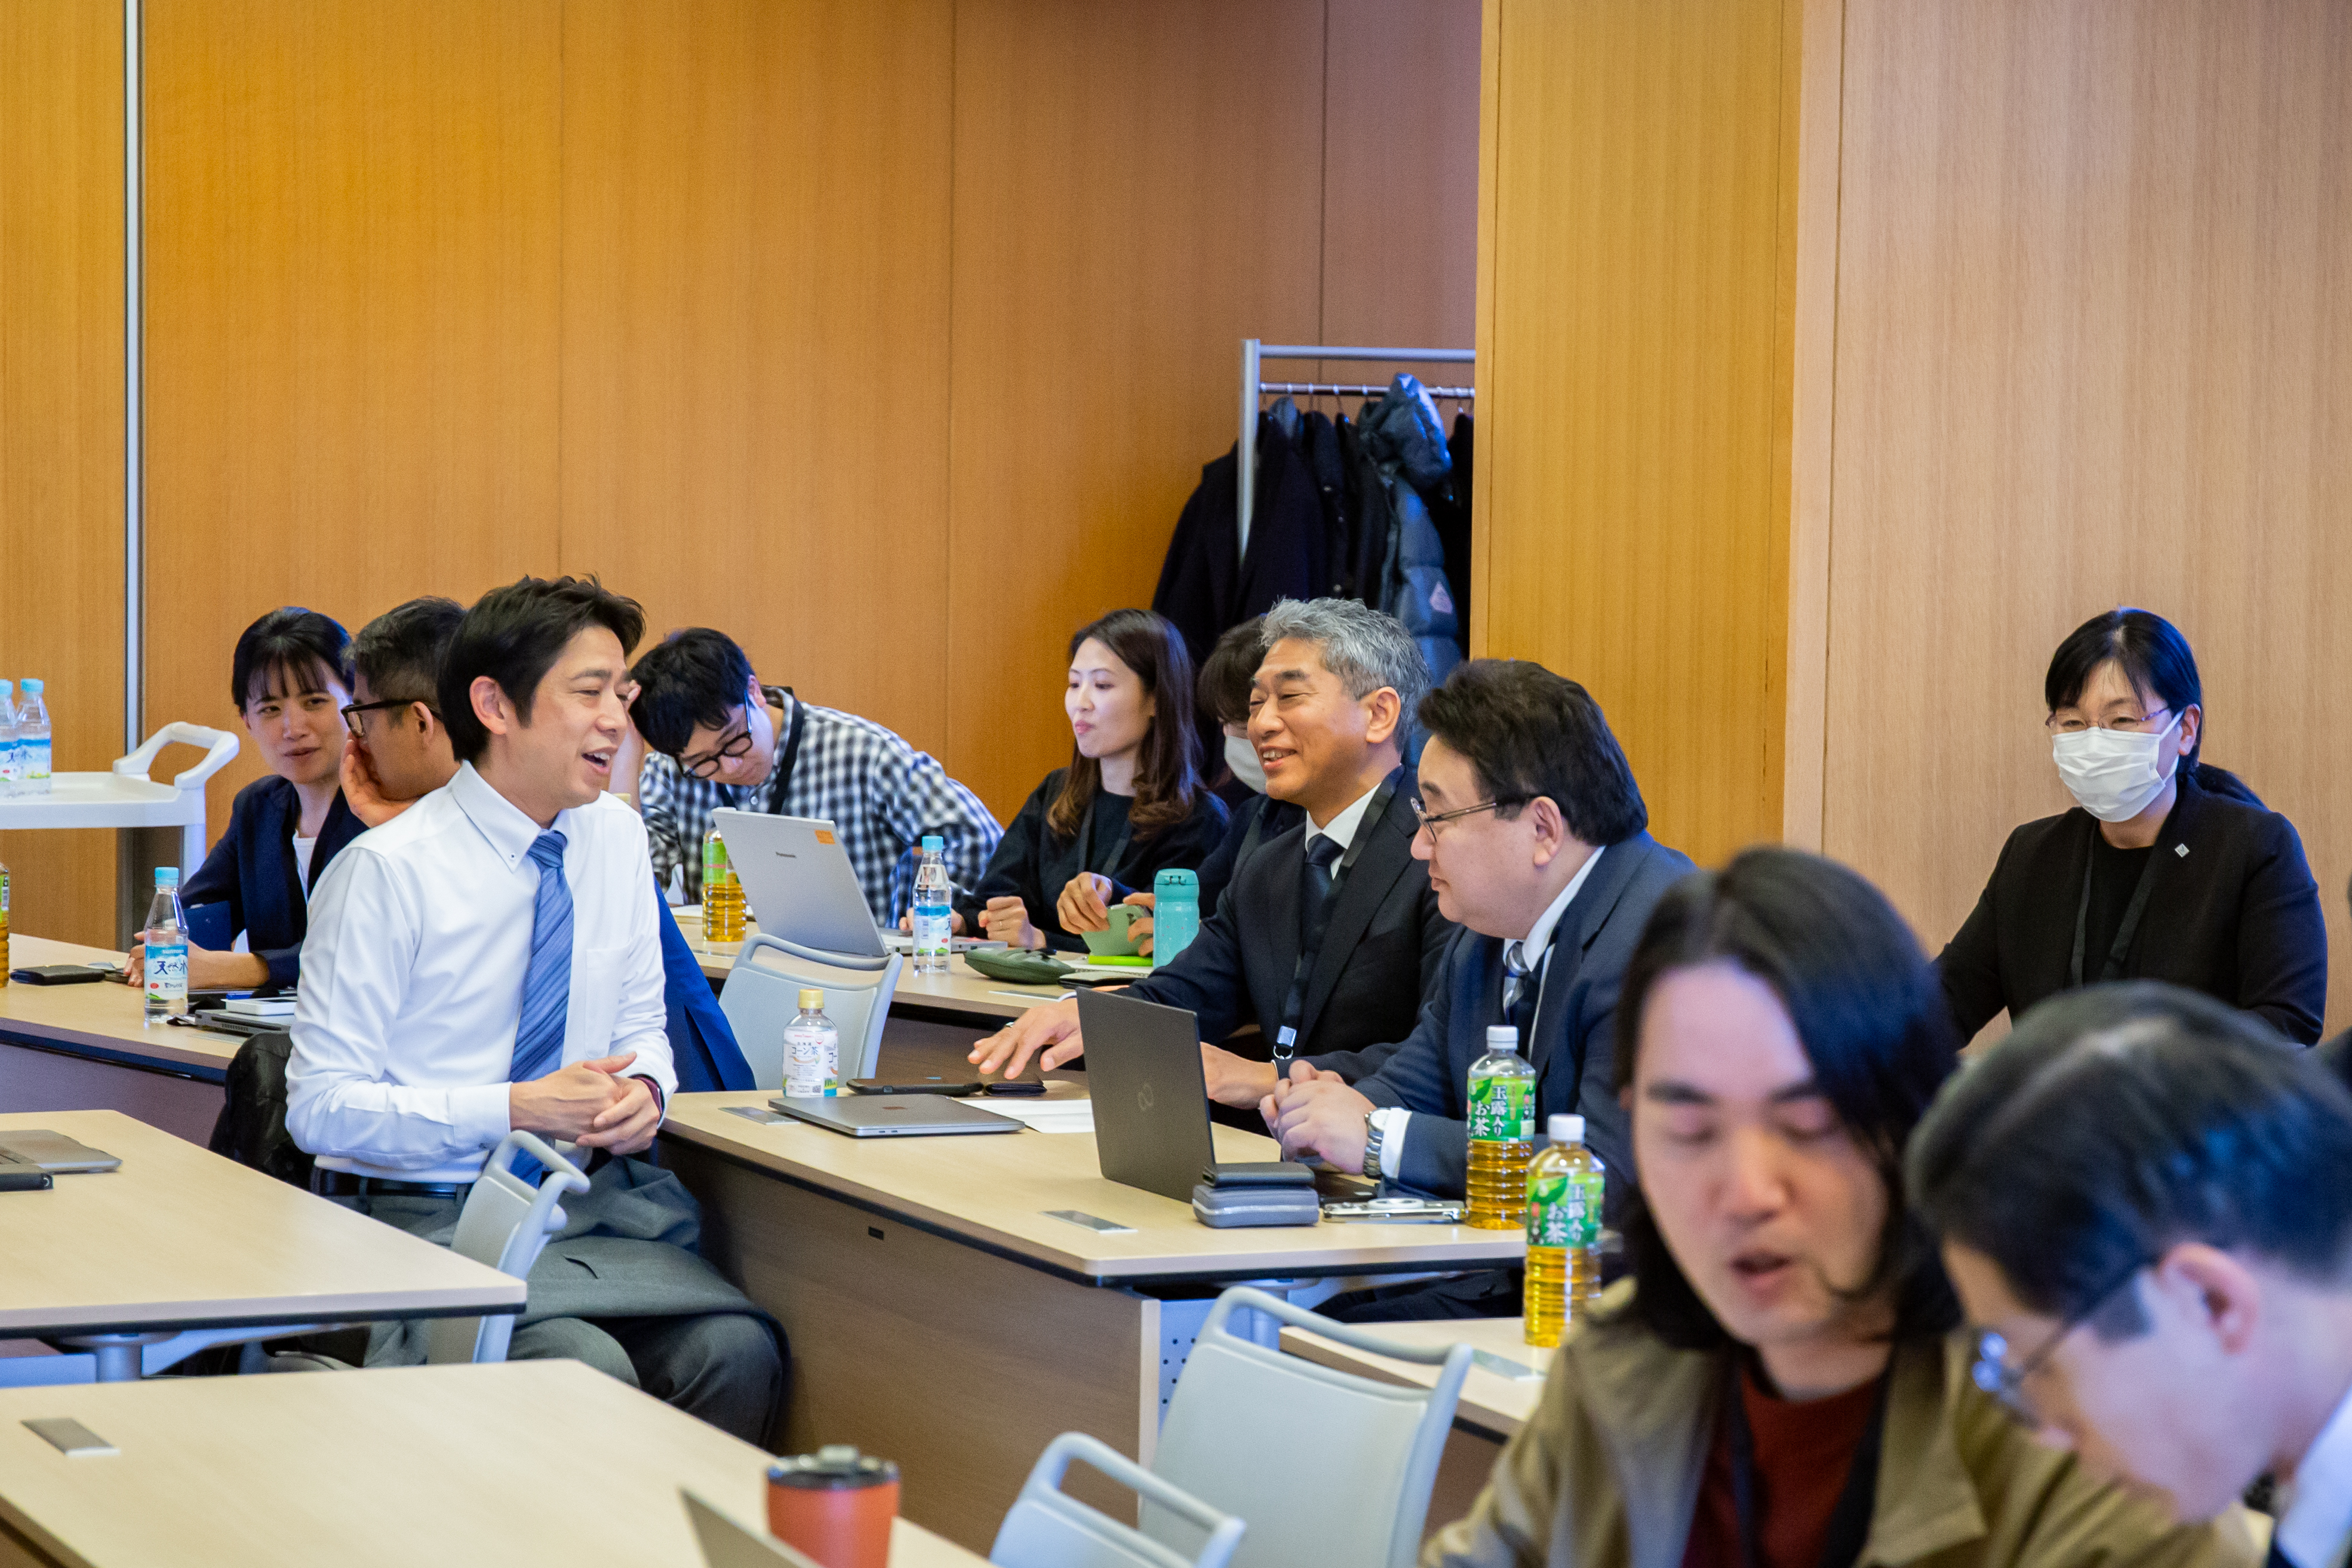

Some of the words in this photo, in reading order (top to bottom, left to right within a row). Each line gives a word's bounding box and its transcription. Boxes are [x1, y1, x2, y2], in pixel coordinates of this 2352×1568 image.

[791, 1046, 819, 1056] コーン茶
[1474, 1100, 1491, 1137] お茶
[1490, 1086, 1508, 1137] 玉露入り
[1545, 1201, 1569, 1244] お茶
